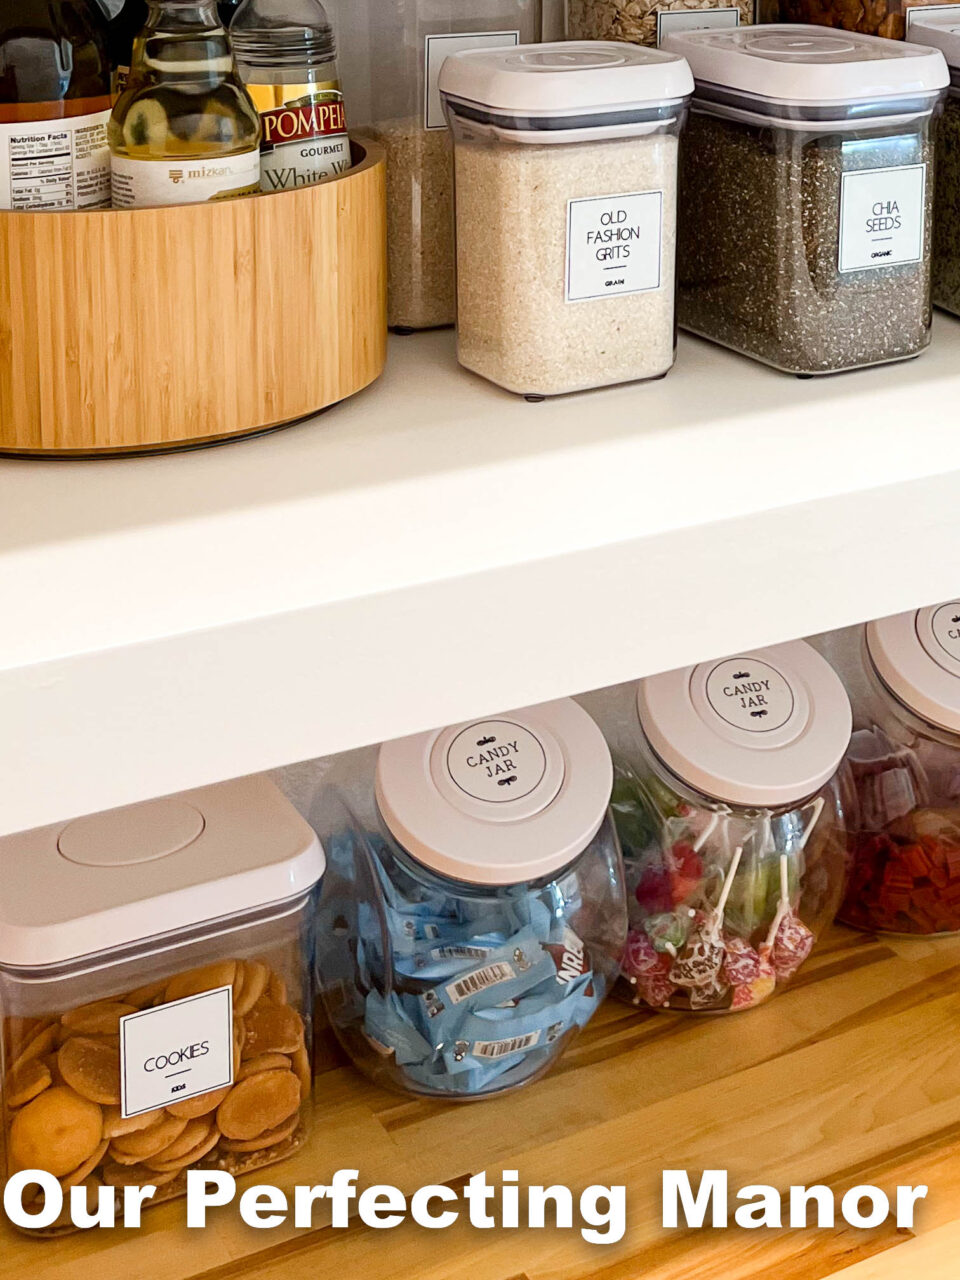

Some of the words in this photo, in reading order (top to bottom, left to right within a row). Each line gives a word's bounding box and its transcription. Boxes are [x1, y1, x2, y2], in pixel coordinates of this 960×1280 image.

[10, 135, 46, 144] Nutrition
[47, 132, 68, 141] Facts
[300, 142, 344, 157] GOURMET
[263, 166, 329, 190] White
[872, 200, 900, 216] CHIA
[600, 209, 628, 226] OLD
[865, 215, 902, 233] SEEDS
[586, 225, 641, 245] FASHION
[595, 244, 631, 261] GRITS
[604, 278, 625, 287] GRAIN
[722, 679, 771, 697] CANDY
[740, 694, 769, 709] JAR
[466, 740, 520, 768] CANDY
[485, 758, 518, 778] JAR
[143, 1040, 210, 1073] COOKIES
